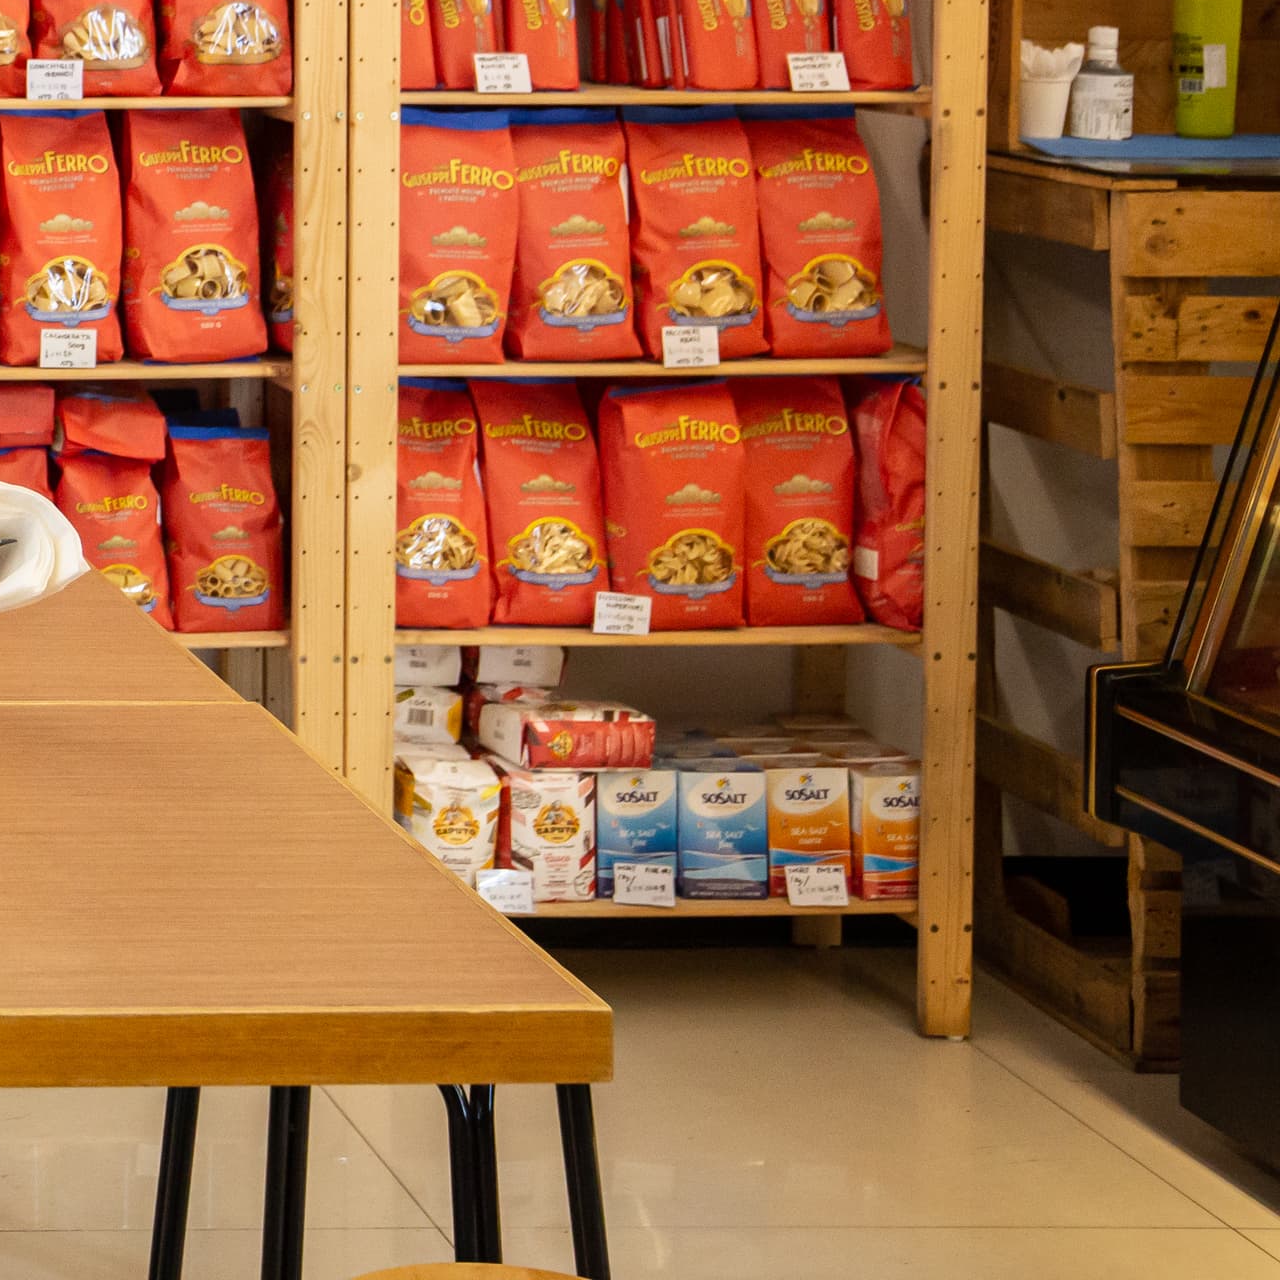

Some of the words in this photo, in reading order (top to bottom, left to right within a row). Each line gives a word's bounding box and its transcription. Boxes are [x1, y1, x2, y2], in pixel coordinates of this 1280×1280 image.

[43, 150, 109, 175] FERRO
[179, 140, 244, 166] FERRO
[559, 150, 619, 177] FERRO
[804, 148, 869, 176] FERRO
[449, 158, 514, 190] FERRO
[683, 153, 750, 180] FERRO
[413, 416, 476, 440] FERRO
[523, 413, 586, 441] FERRO
[679, 414, 742, 445] FERRO
[782, 407, 848, 436] FERRO
[104, 494, 148, 515] FERRO
[221, 483, 265, 505] FERRO
[616, 791, 658, 804] SOSALT
[702, 792, 746, 805] SOSALT
[786, 788, 829, 802] SOSALT
[436, 827, 475, 835] CAPUTO
